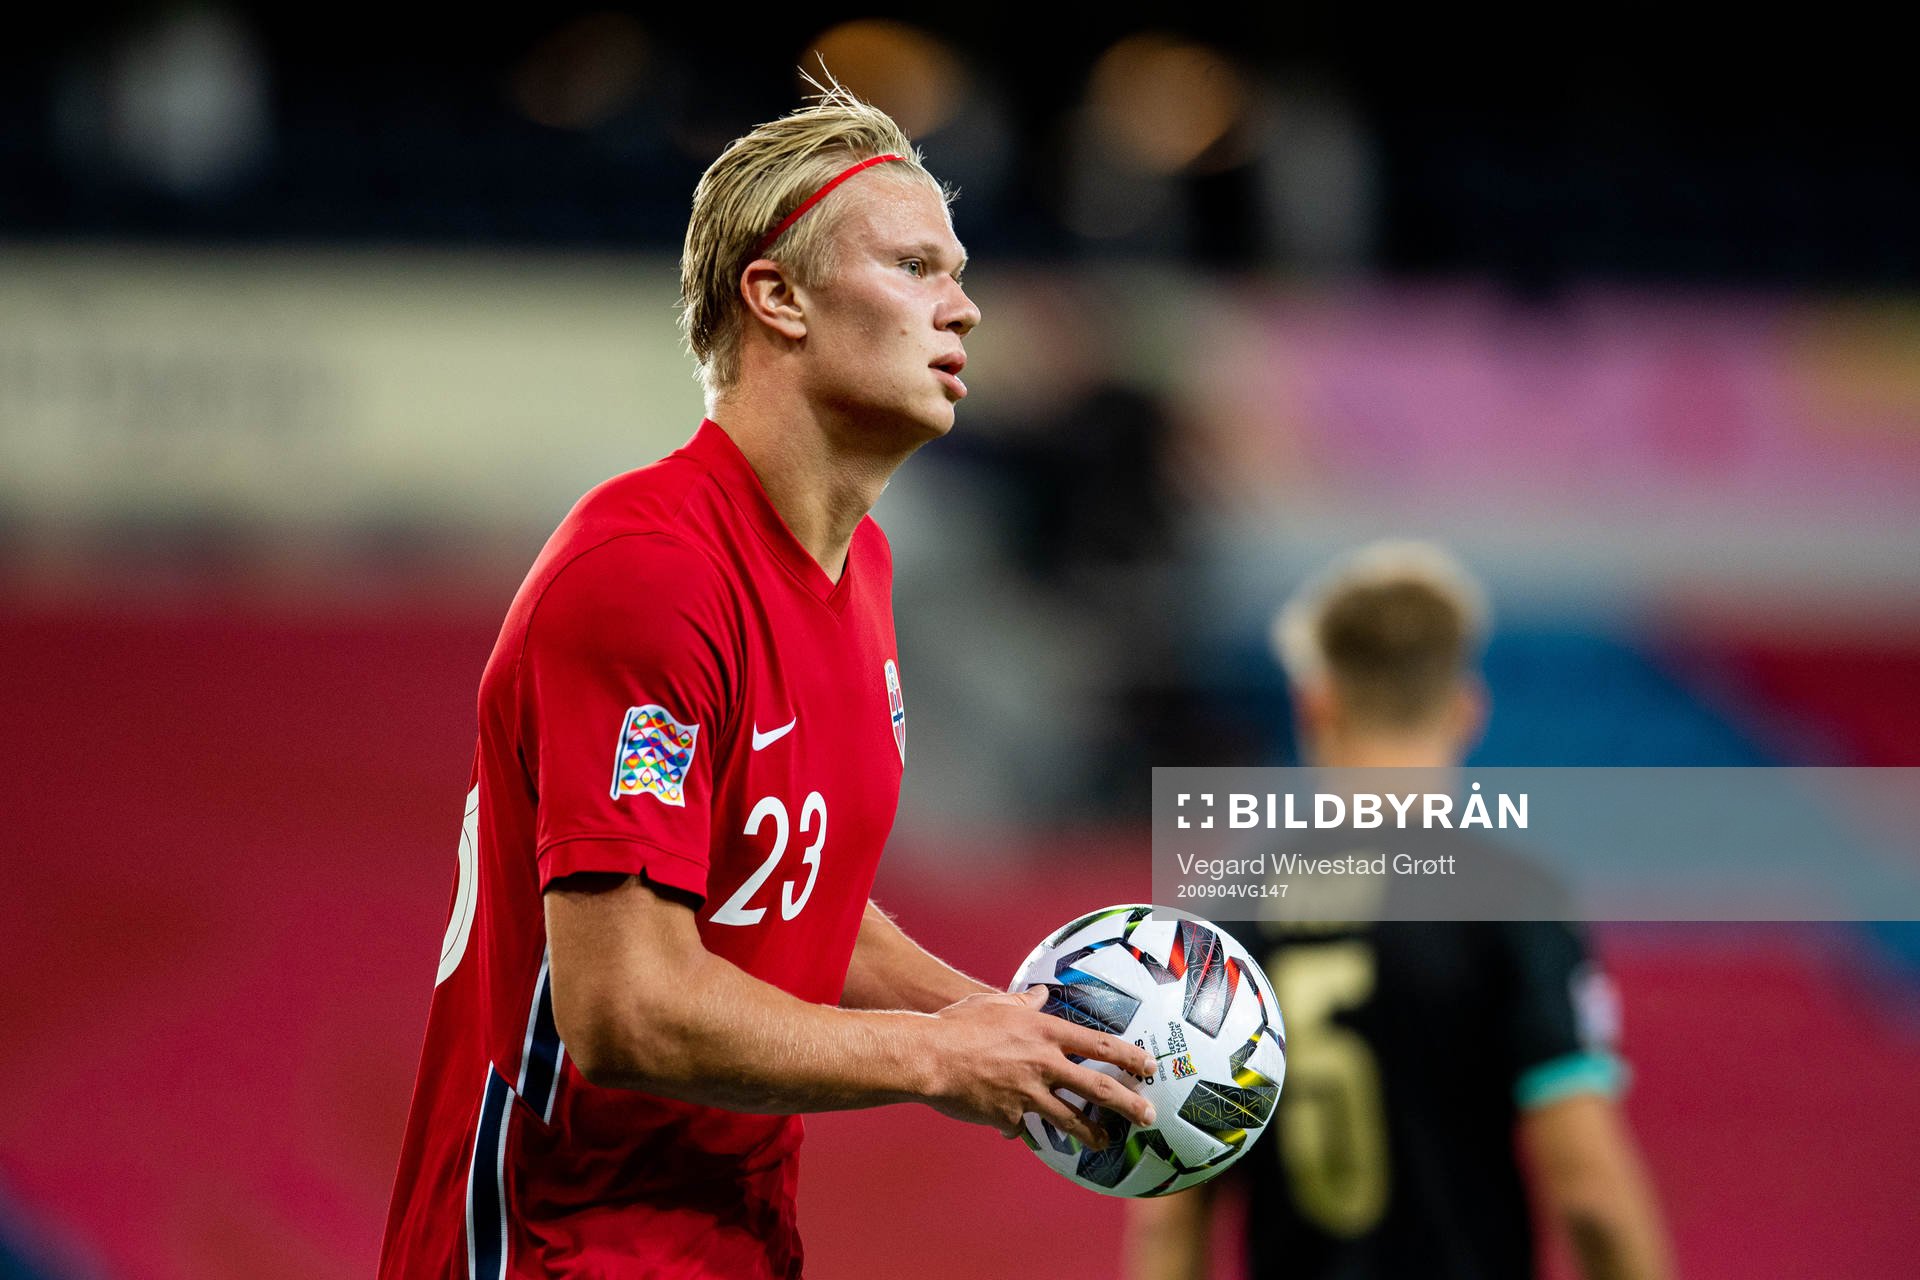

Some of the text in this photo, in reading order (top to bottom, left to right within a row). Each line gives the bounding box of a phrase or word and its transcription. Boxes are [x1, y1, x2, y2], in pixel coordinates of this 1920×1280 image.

[709, 791, 827, 926] 23
[1167, 1036, 1177, 1055] UEFA
[1168, 1020, 1182, 1054] NATIONS
[1174, 1023, 1188, 1052] LEAGUE
